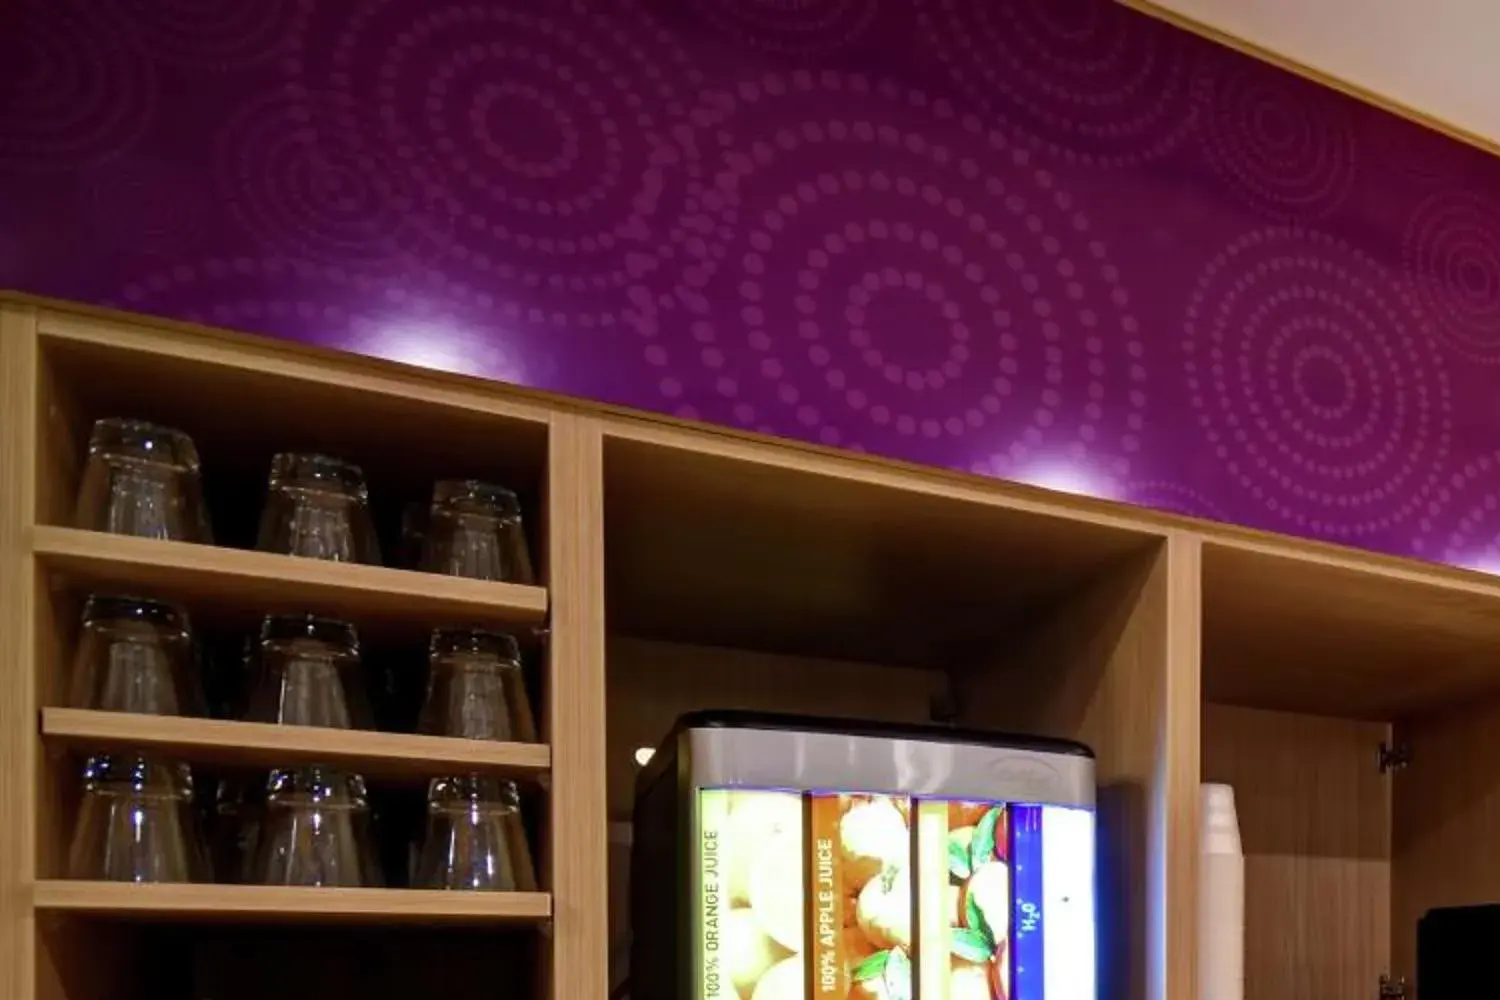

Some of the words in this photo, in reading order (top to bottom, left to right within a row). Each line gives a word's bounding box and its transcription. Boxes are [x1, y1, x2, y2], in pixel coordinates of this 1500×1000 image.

[703, 829, 719, 877] JUICE
[817, 838, 833, 887] JUICE
[705, 883, 720, 951] ORANGE
[818, 890, 834, 946] APPLE
[705, 956, 721, 999] 100%
[820, 950, 836, 993] 100%
